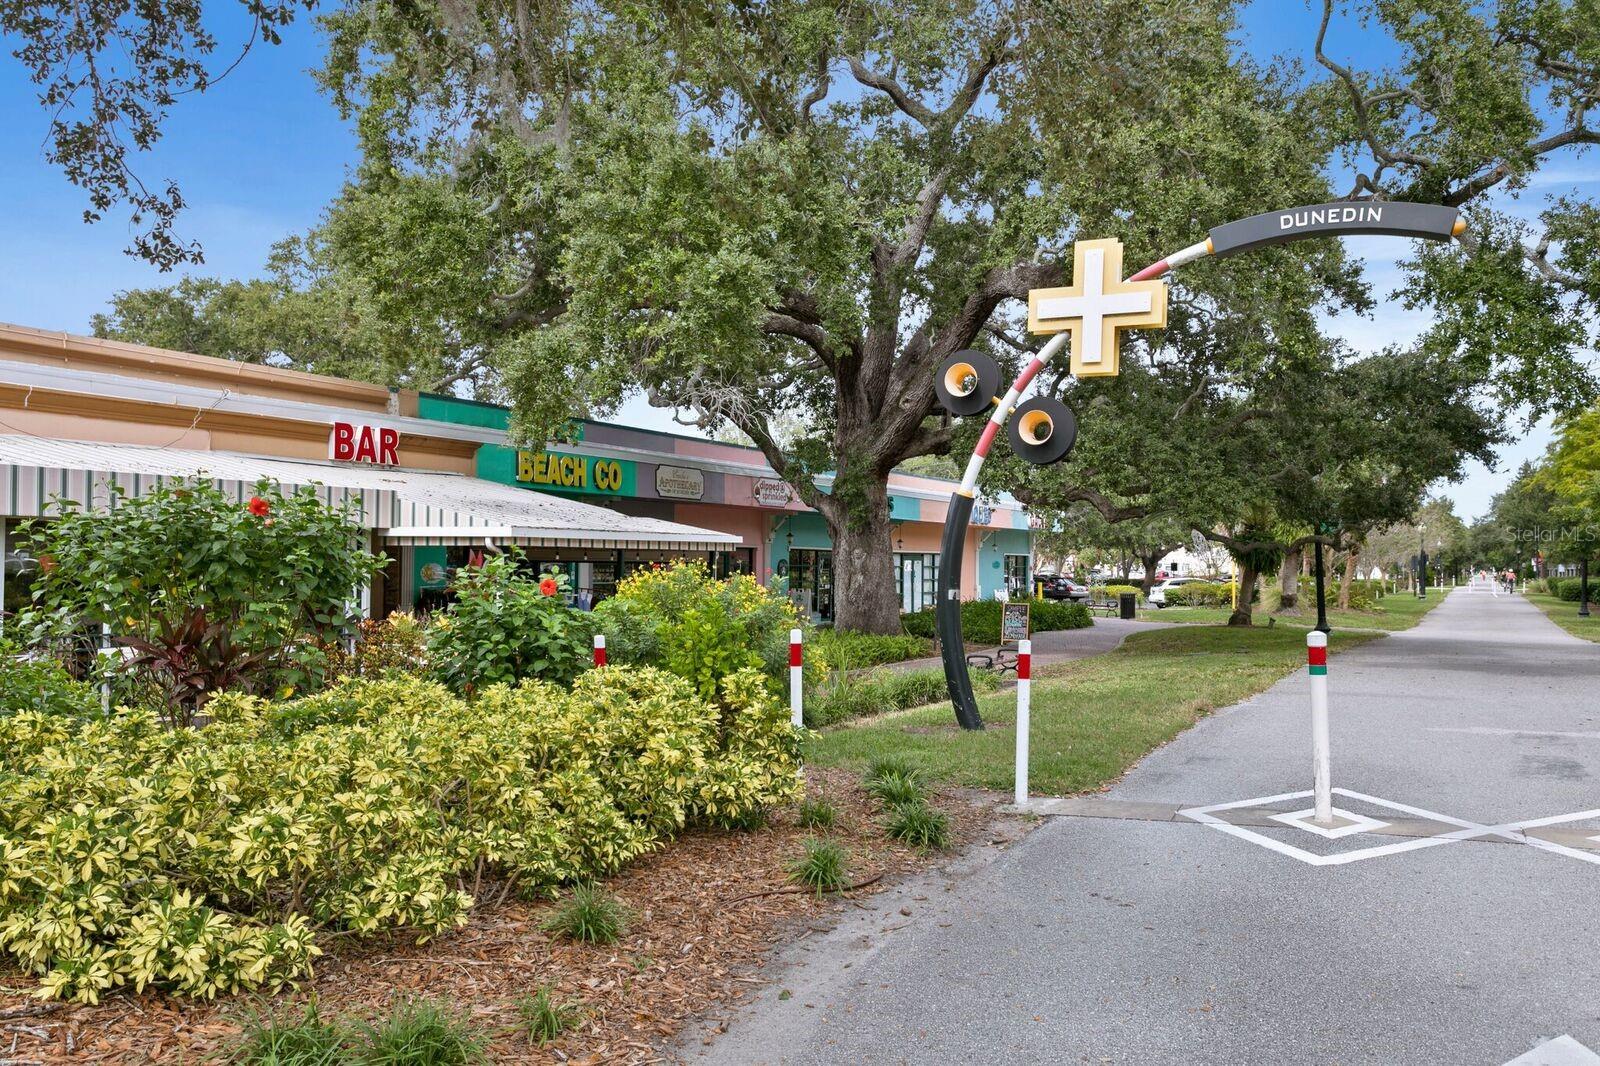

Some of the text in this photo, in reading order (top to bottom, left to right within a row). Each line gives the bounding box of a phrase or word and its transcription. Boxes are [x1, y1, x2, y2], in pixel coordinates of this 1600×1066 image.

[1280, 207, 1382, 230] DUNEDIN
[332, 421, 400, 466] BAR
[518, 449, 622, 491] BEACH CO
[760, 480, 780, 493] dipped
